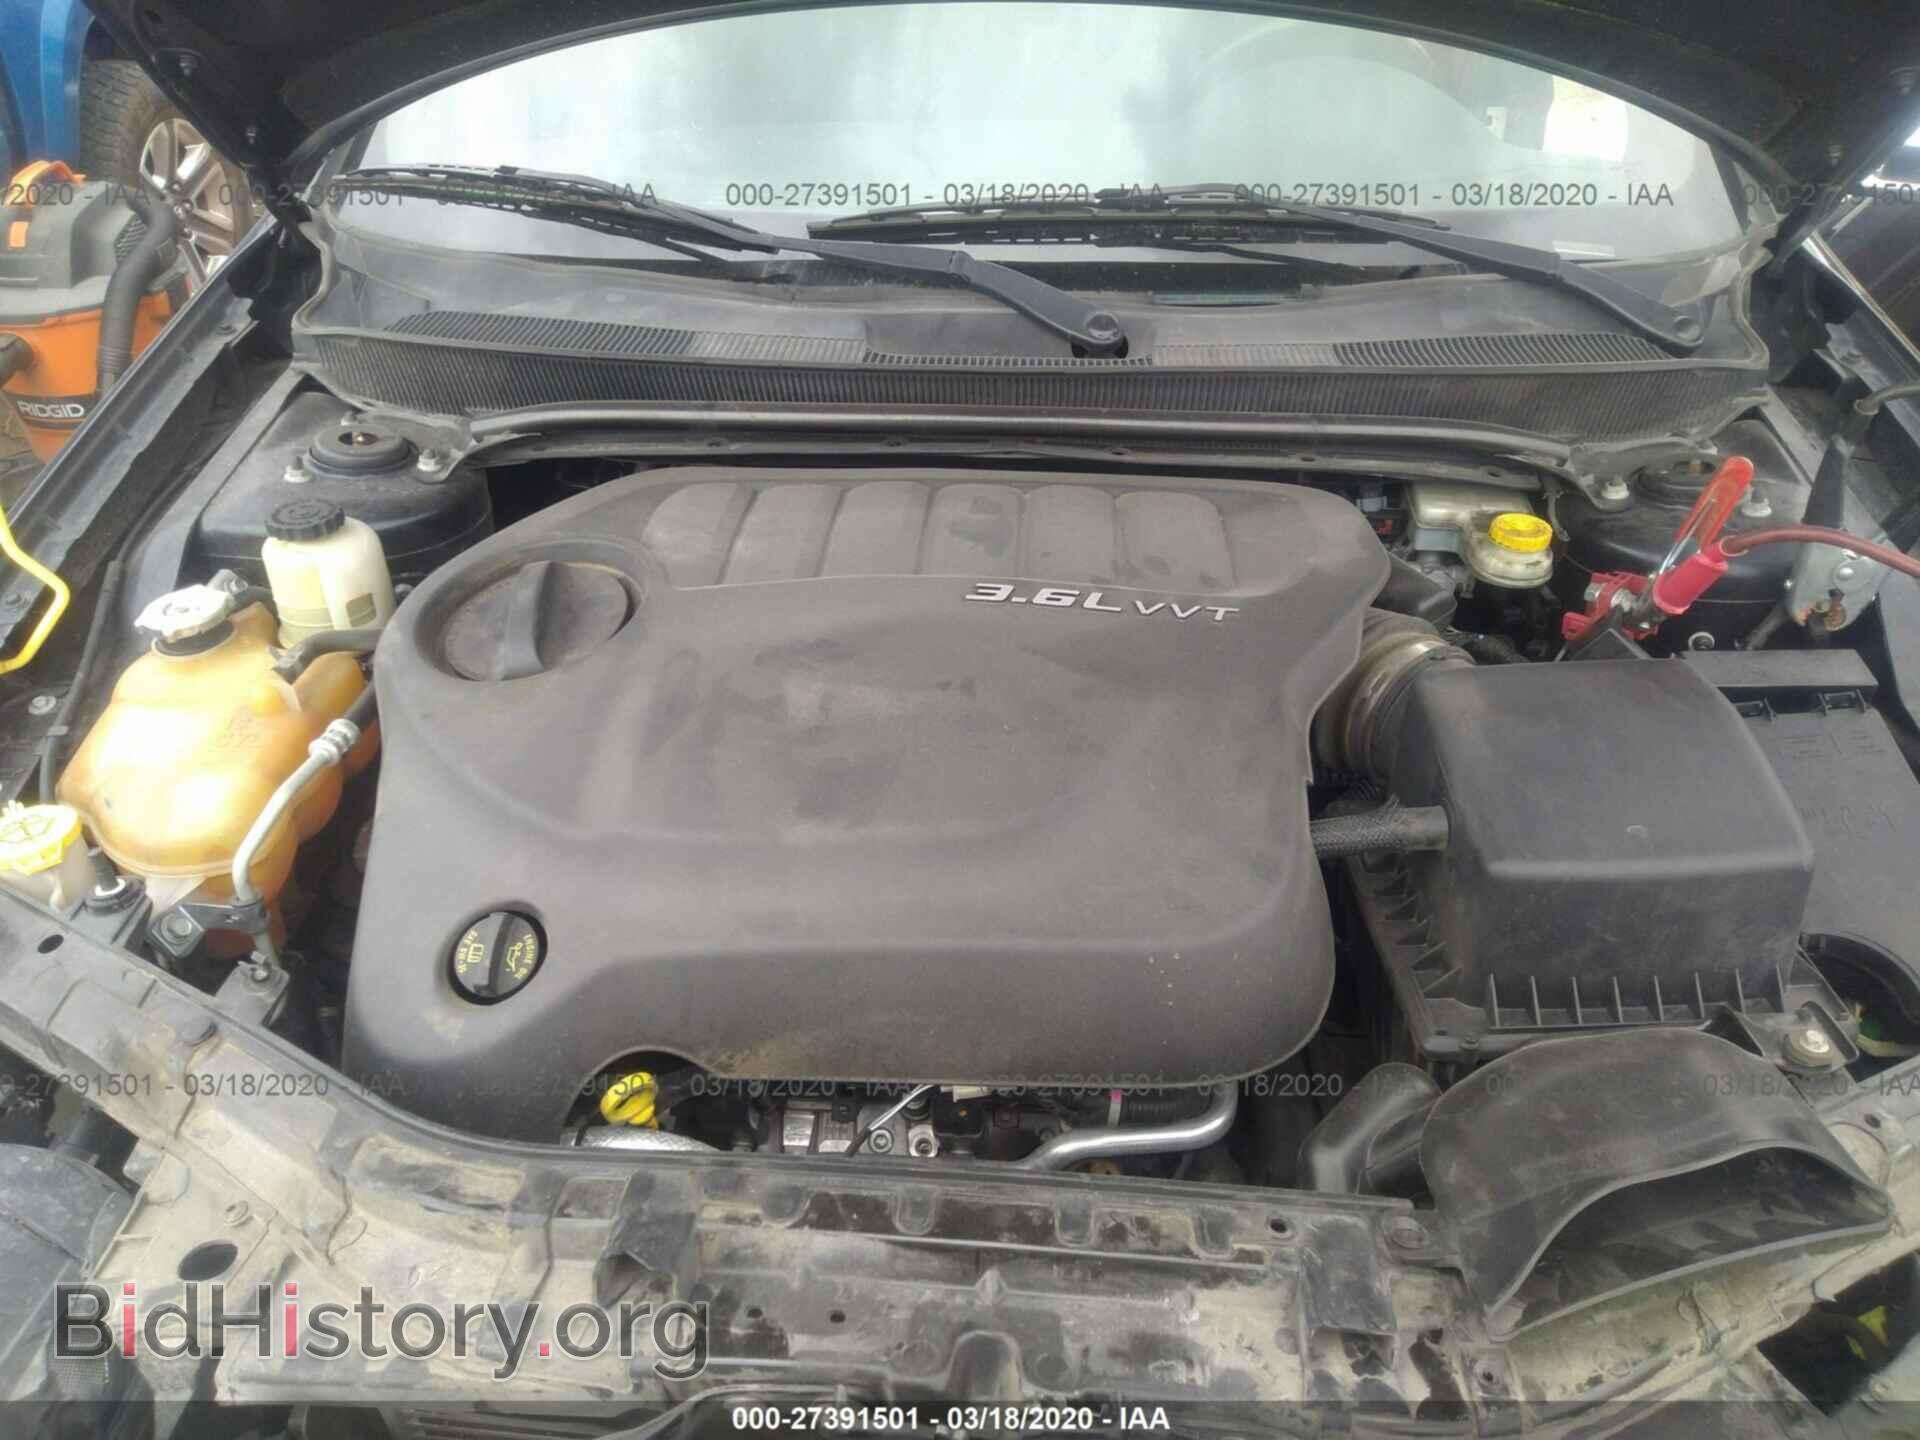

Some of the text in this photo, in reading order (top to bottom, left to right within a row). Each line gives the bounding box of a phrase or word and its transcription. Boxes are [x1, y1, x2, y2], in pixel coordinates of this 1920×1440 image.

[16, 400, 85, 418] RIDGID
[965, 583, 1241, 621] 3.6L VVT
